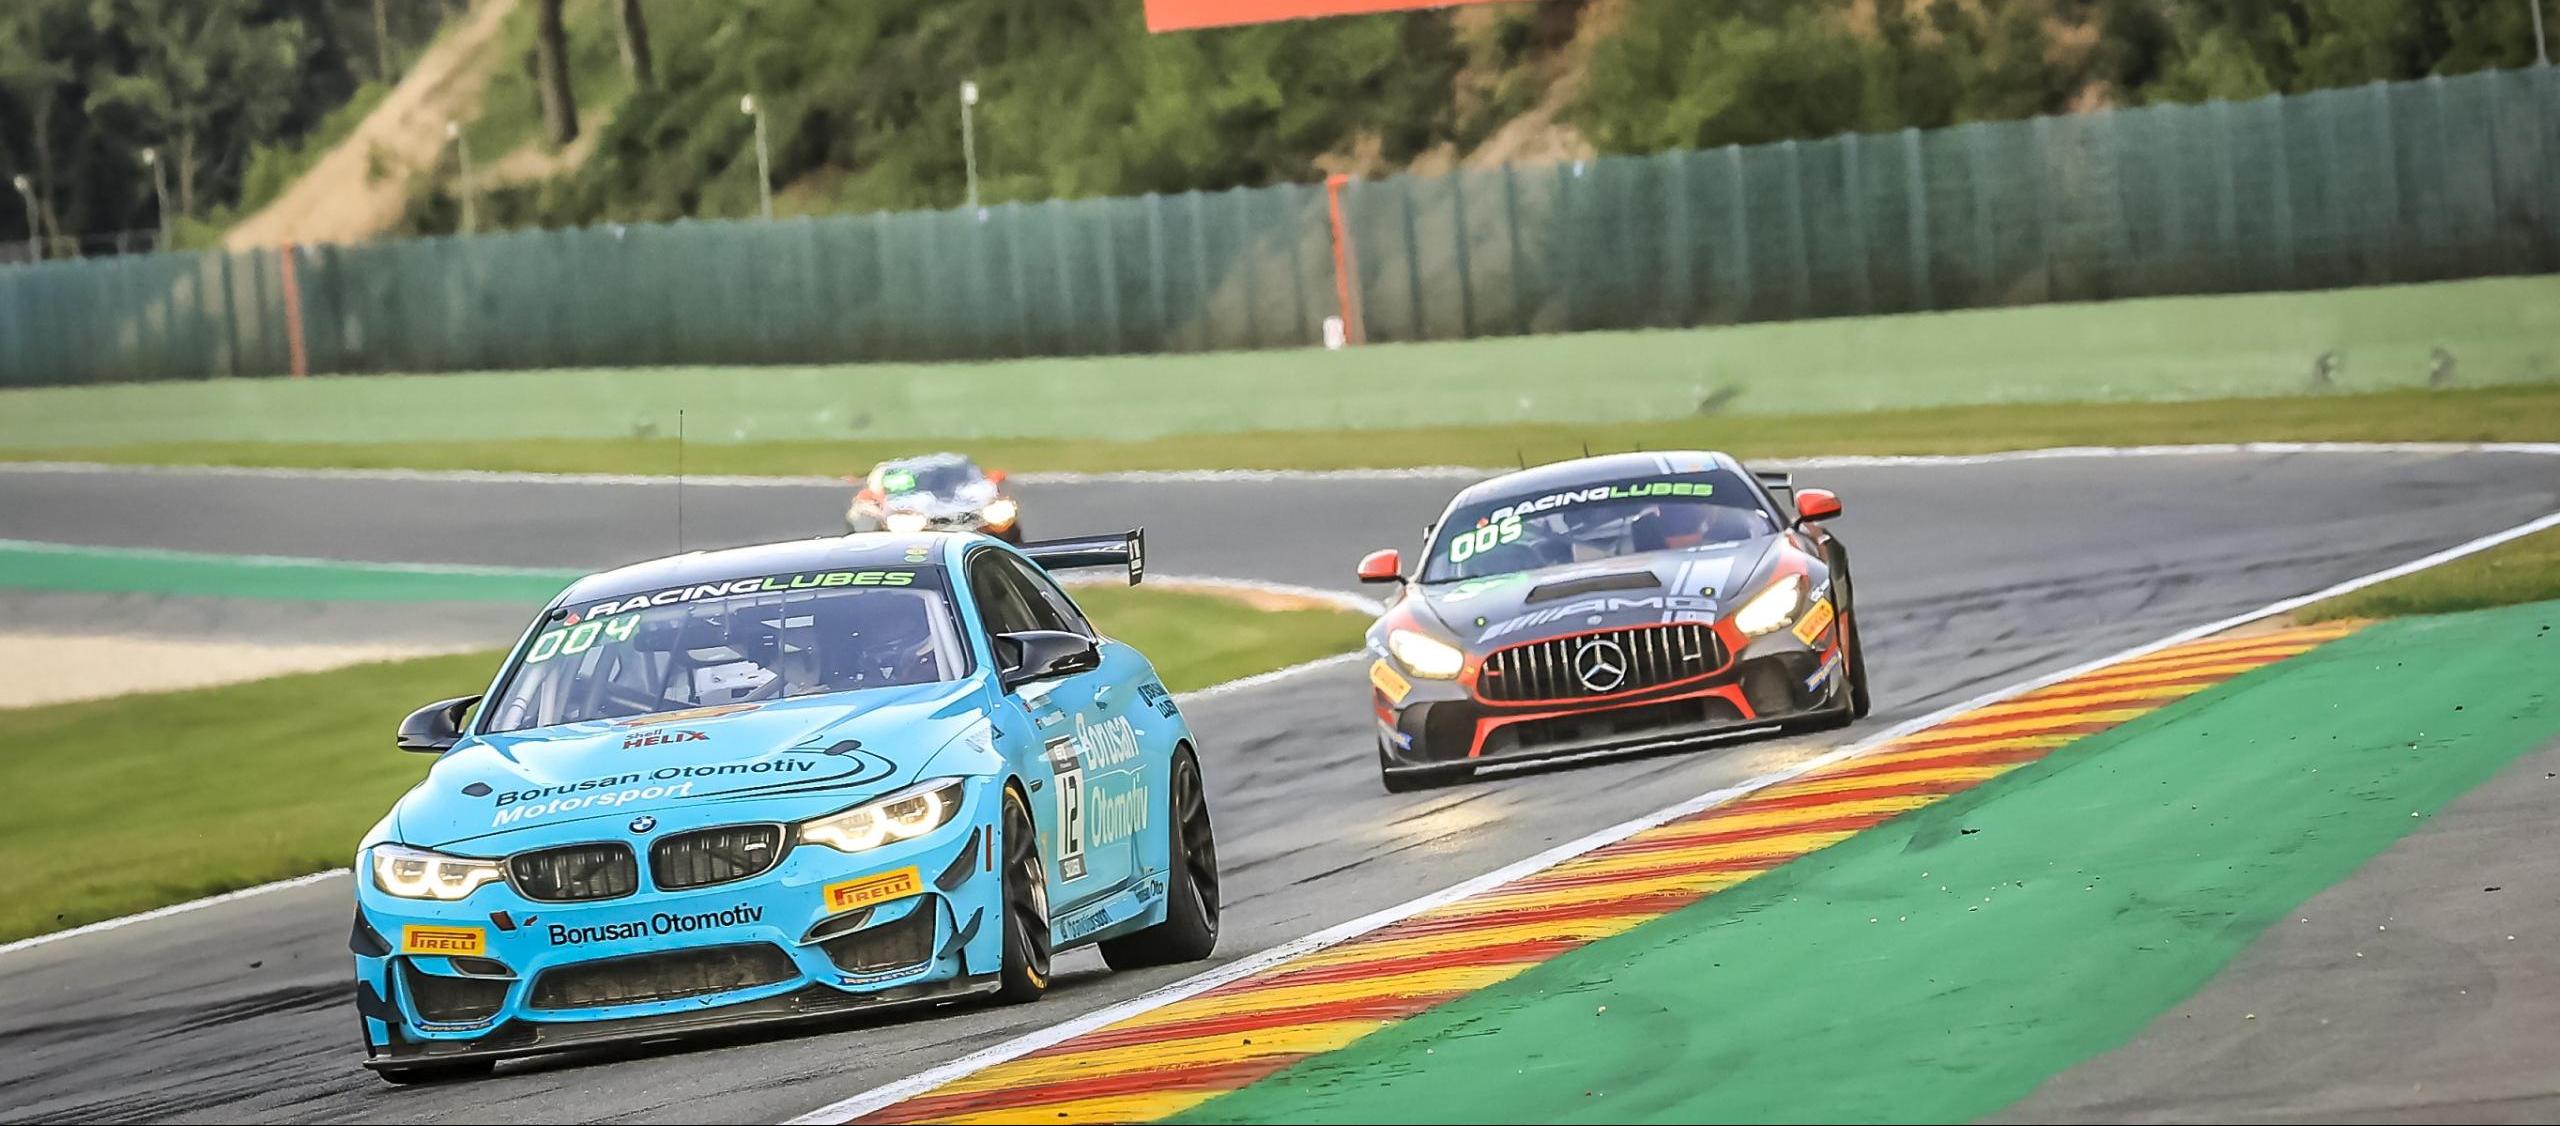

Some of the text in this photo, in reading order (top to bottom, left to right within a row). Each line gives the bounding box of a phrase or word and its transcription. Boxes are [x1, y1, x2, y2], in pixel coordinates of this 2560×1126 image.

[585, 571, 916, 621] RACINGLUBES
[526, 614, 642, 664] 004
[622, 730, 711, 749] HELIX
[1075, 712, 1140, 771] Borusan
[491, 781, 692, 828] Motorsport
[495, 758, 816, 807] Borusan Otomotiv
[1063, 775, 1078, 855] 12
[1091, 773, 1148, 848] Otomotiv
[833, 873, 911, 906] PIRELLI
[410, 931, 477, 950] PIRELLI
[550, 903, 763, 945] Borusan Otomotiv
